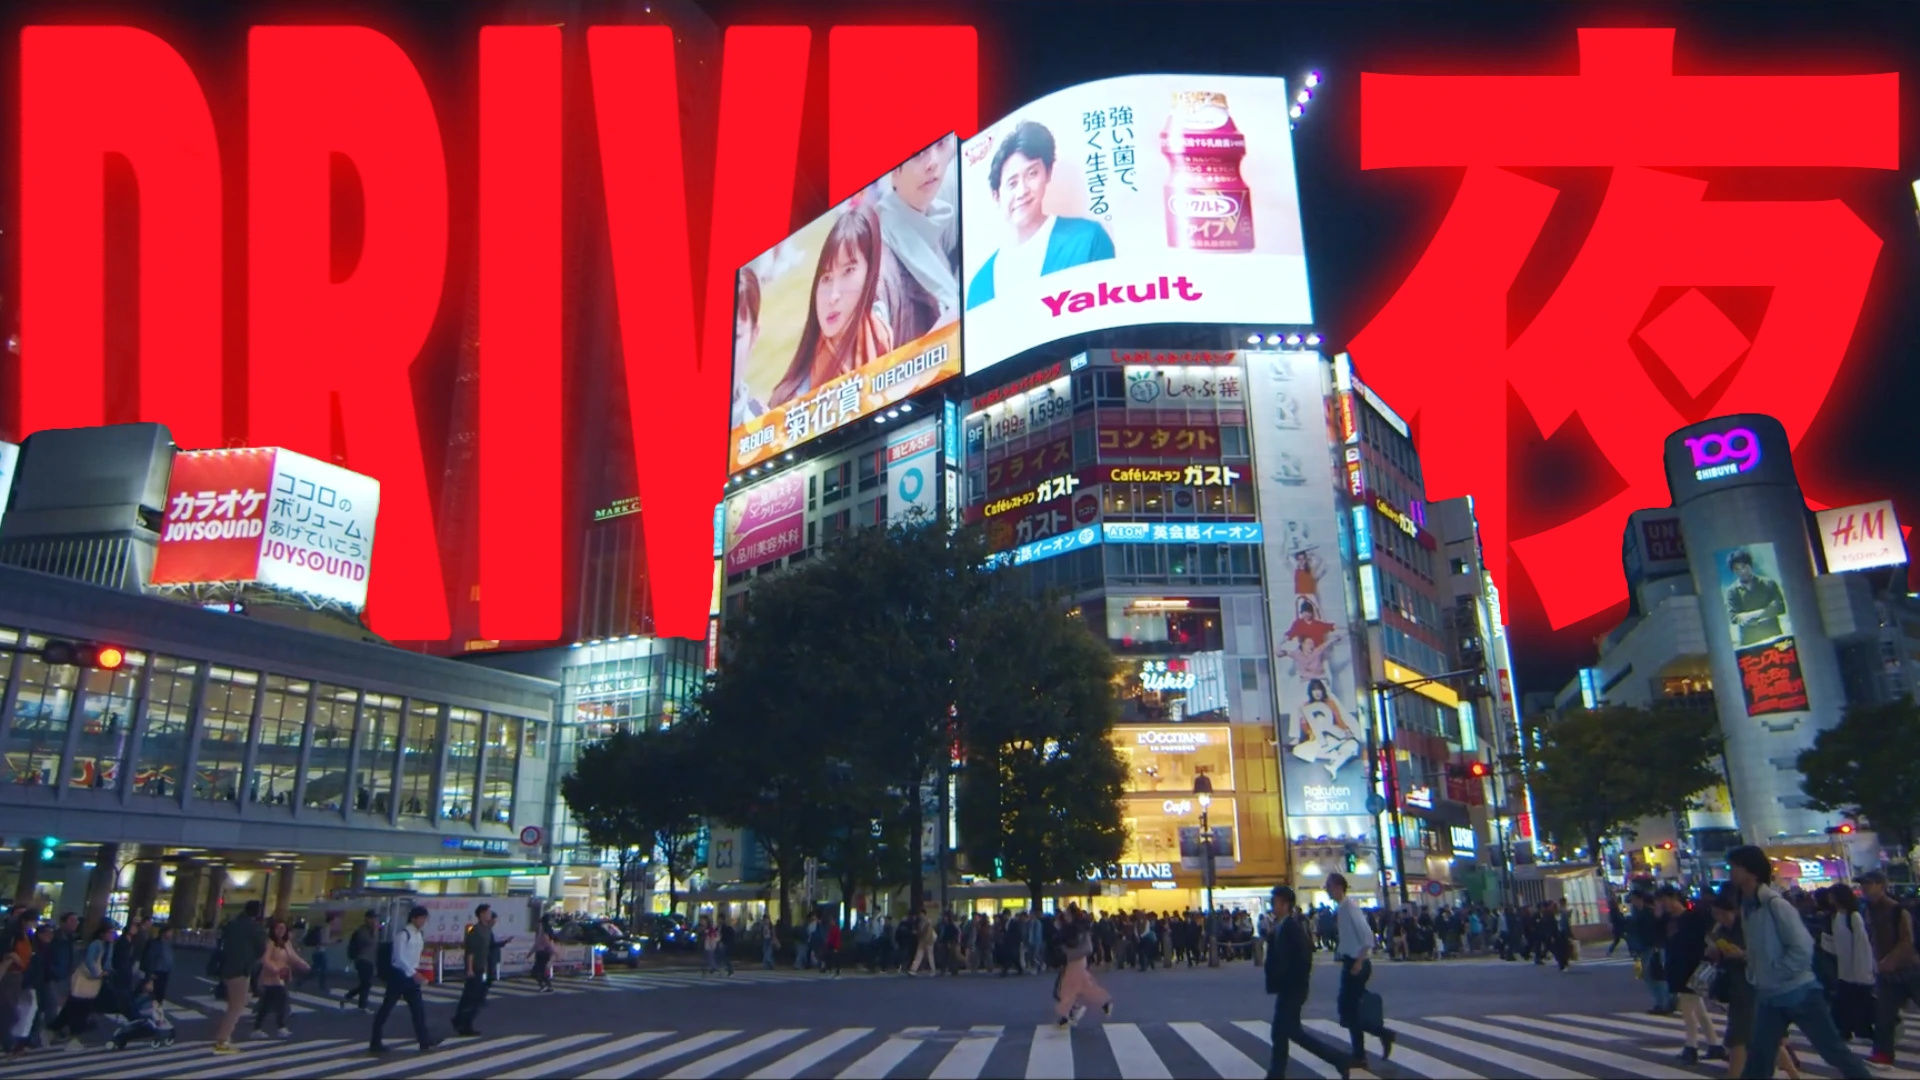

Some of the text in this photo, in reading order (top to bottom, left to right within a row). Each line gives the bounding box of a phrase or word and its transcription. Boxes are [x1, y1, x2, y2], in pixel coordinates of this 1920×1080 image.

[1109, 106, 1138, 193] 強い菌で、
[1083, 110, 1113, 222] 強く生きる。
[1041, 275, 1203, 317] Yakult
[871, 344, 948, 394] 10月20日(日)
[1166, 376, 1240, 398] しゃぶ葉
[784, 373, 864, 442] 菊花賞
[738, 425, 776, 455] 第80回
[968, 426, 984, 443] 9F
[1099, 428, 1217, 450] コンタクト
[1684, 428, 1758, 472] 109
[1184, 465, 1240, 486] ガスト
[1695, 463, 1738, 481] SHIBUYA
[169, 488, 267, 521] カラオケ
[275, 472, 353, 512] ココロの
[271, 497, 370, 543] ボリューム、
[595, 505, 630, 518] MARK
[163, 518, 263, 542] JOYSOUND
[1015, 509, 1068, 543] ガスト
[1107, 525, 1145, 540] AEON
[1153, 524, 1258, 540] 英会話イーオン
[1831, 508, 1886, 547] H&M
[269, 523, 368, 562] あげていこう。
[736, 530, 800, 566] 品川美容外科
[262, 540, 366, 583] JOYSOUND
[1138, 671, 1197, 691] Ushi8
[1137, 731, 1208, 744] L'OCCITANE
[1303, 785, 1351, 798] Rakuten
[1163, 800, 1191, 815] Café
[1304, 799, 1349, 813] Fashion
[1450, 825, 1475, 850] LUSH
